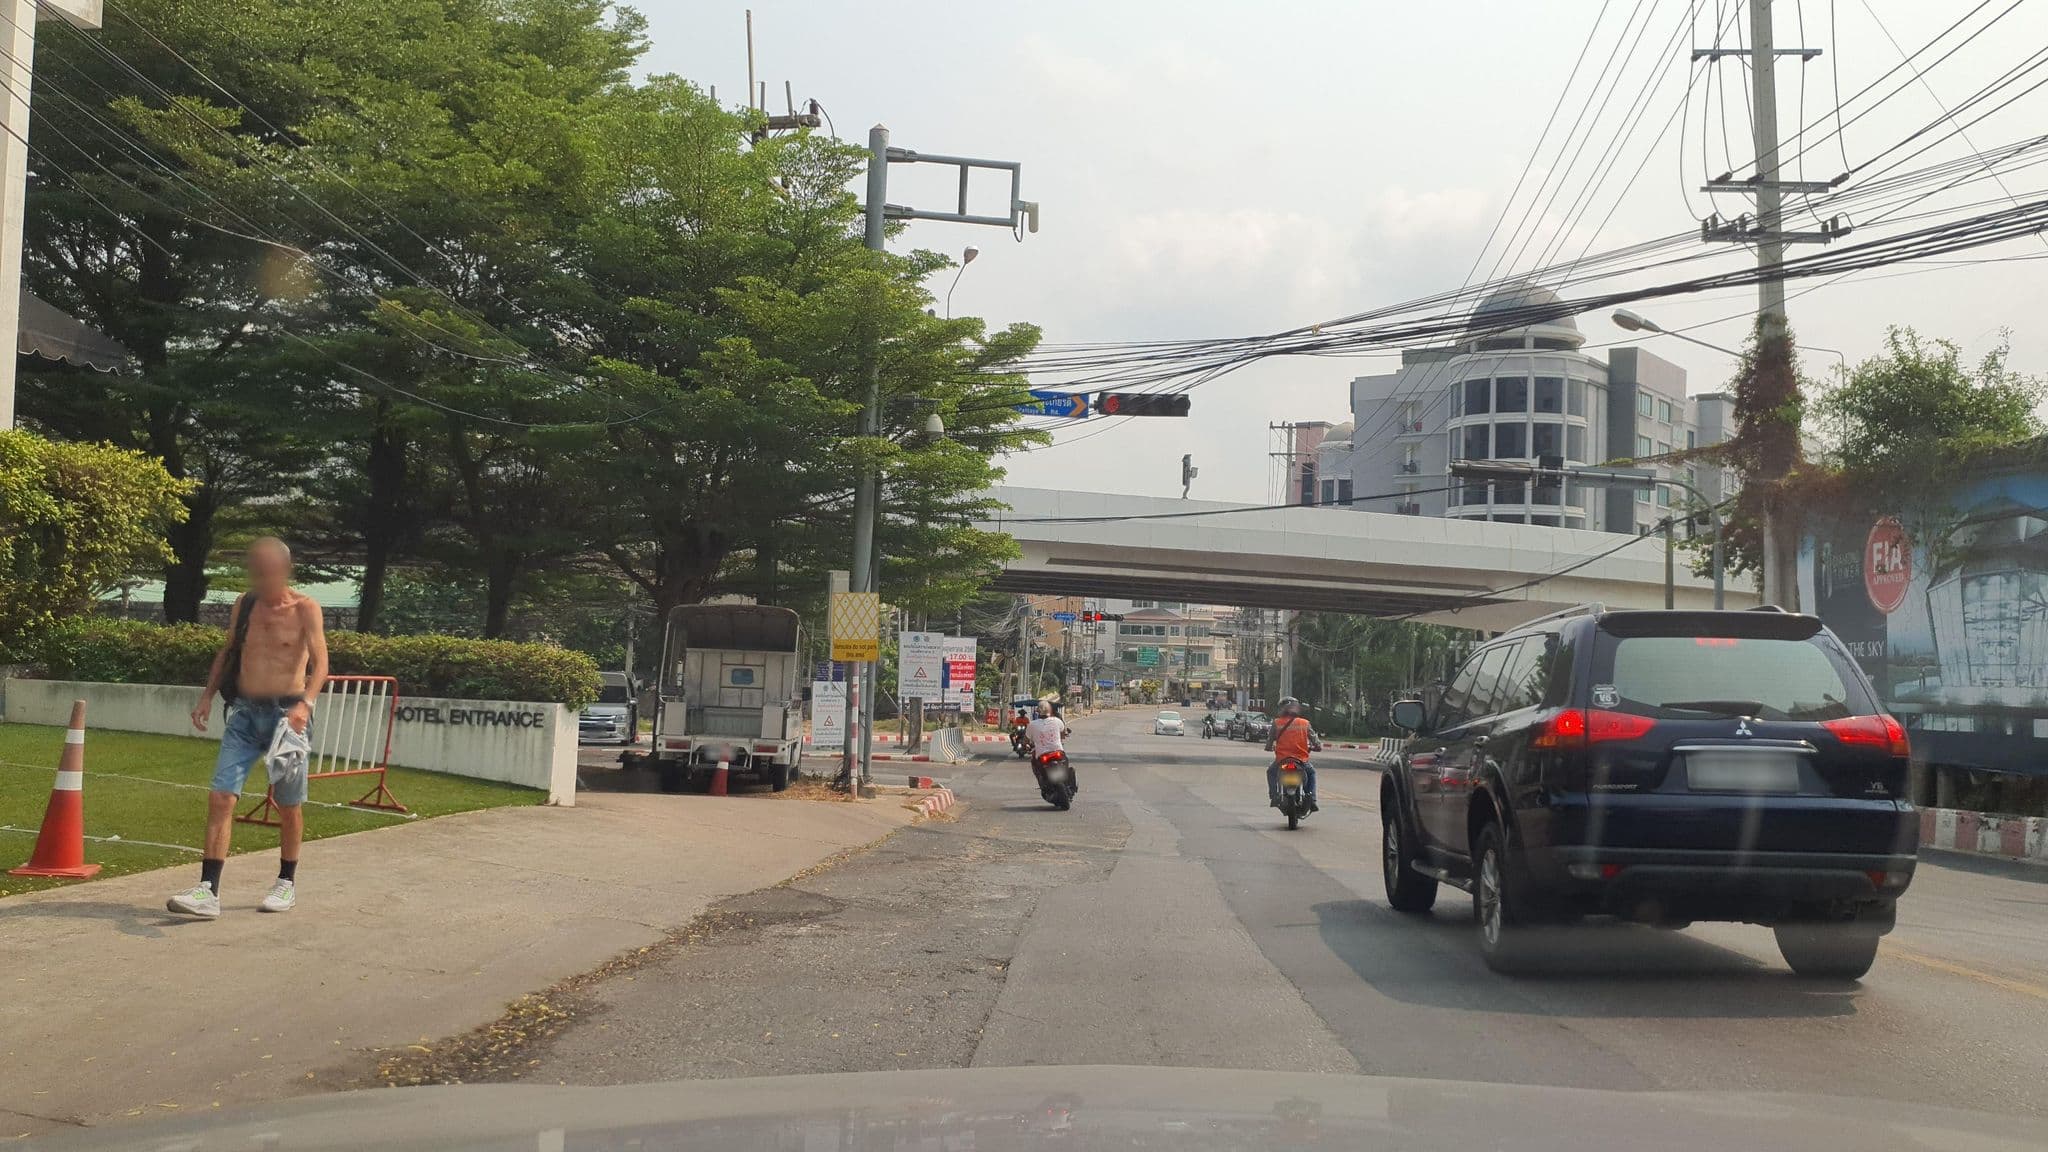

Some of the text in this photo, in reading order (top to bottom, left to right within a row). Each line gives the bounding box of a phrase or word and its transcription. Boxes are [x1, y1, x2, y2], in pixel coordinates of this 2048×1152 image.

[1848, 640, 1884, 657] THE SKY
[449, 708, 545, 728] ENTRANCE
